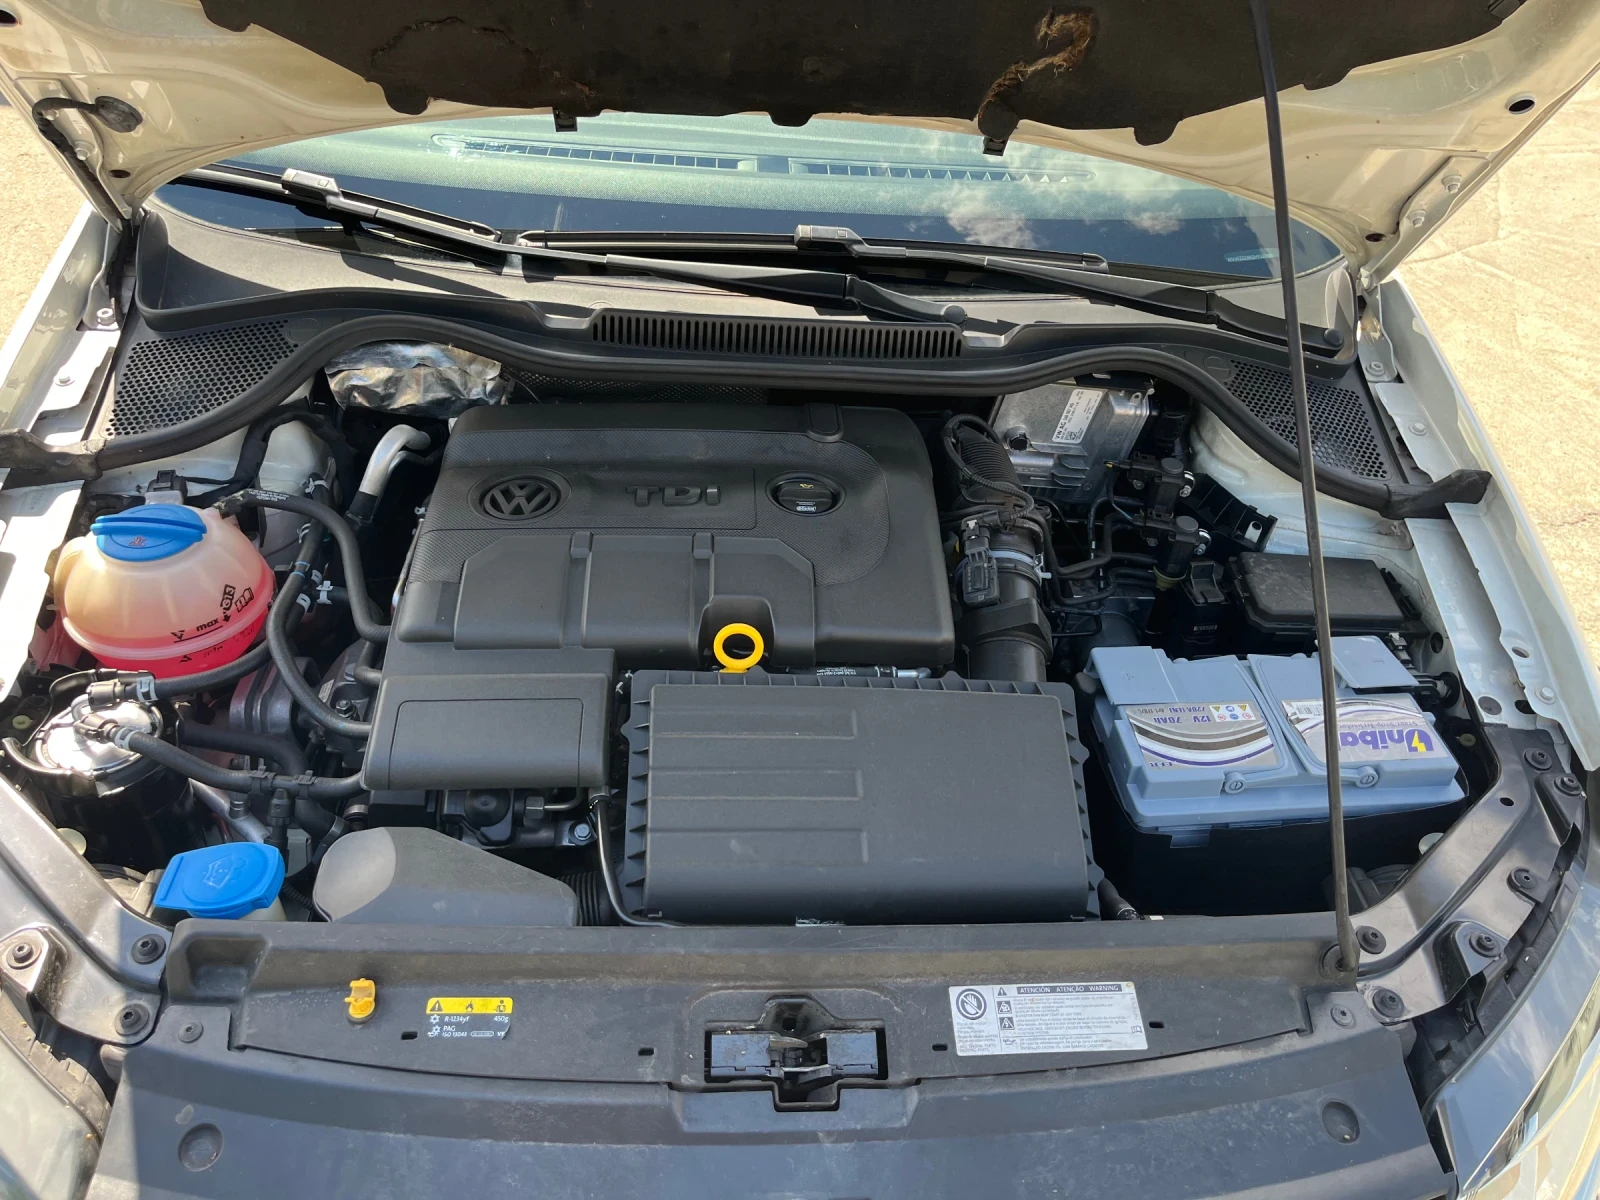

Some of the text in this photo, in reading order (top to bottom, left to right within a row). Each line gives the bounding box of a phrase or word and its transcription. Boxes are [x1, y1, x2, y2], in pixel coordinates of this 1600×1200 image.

[1055, 430, 1062, 439] VW
[196, 618, 219, 631] max
[1338, 728, 1434, 752] Uniba
[1056, 985, 1084, 993] ATENÇÃO
[444, 1016, 470, 1024] R-1234yf
